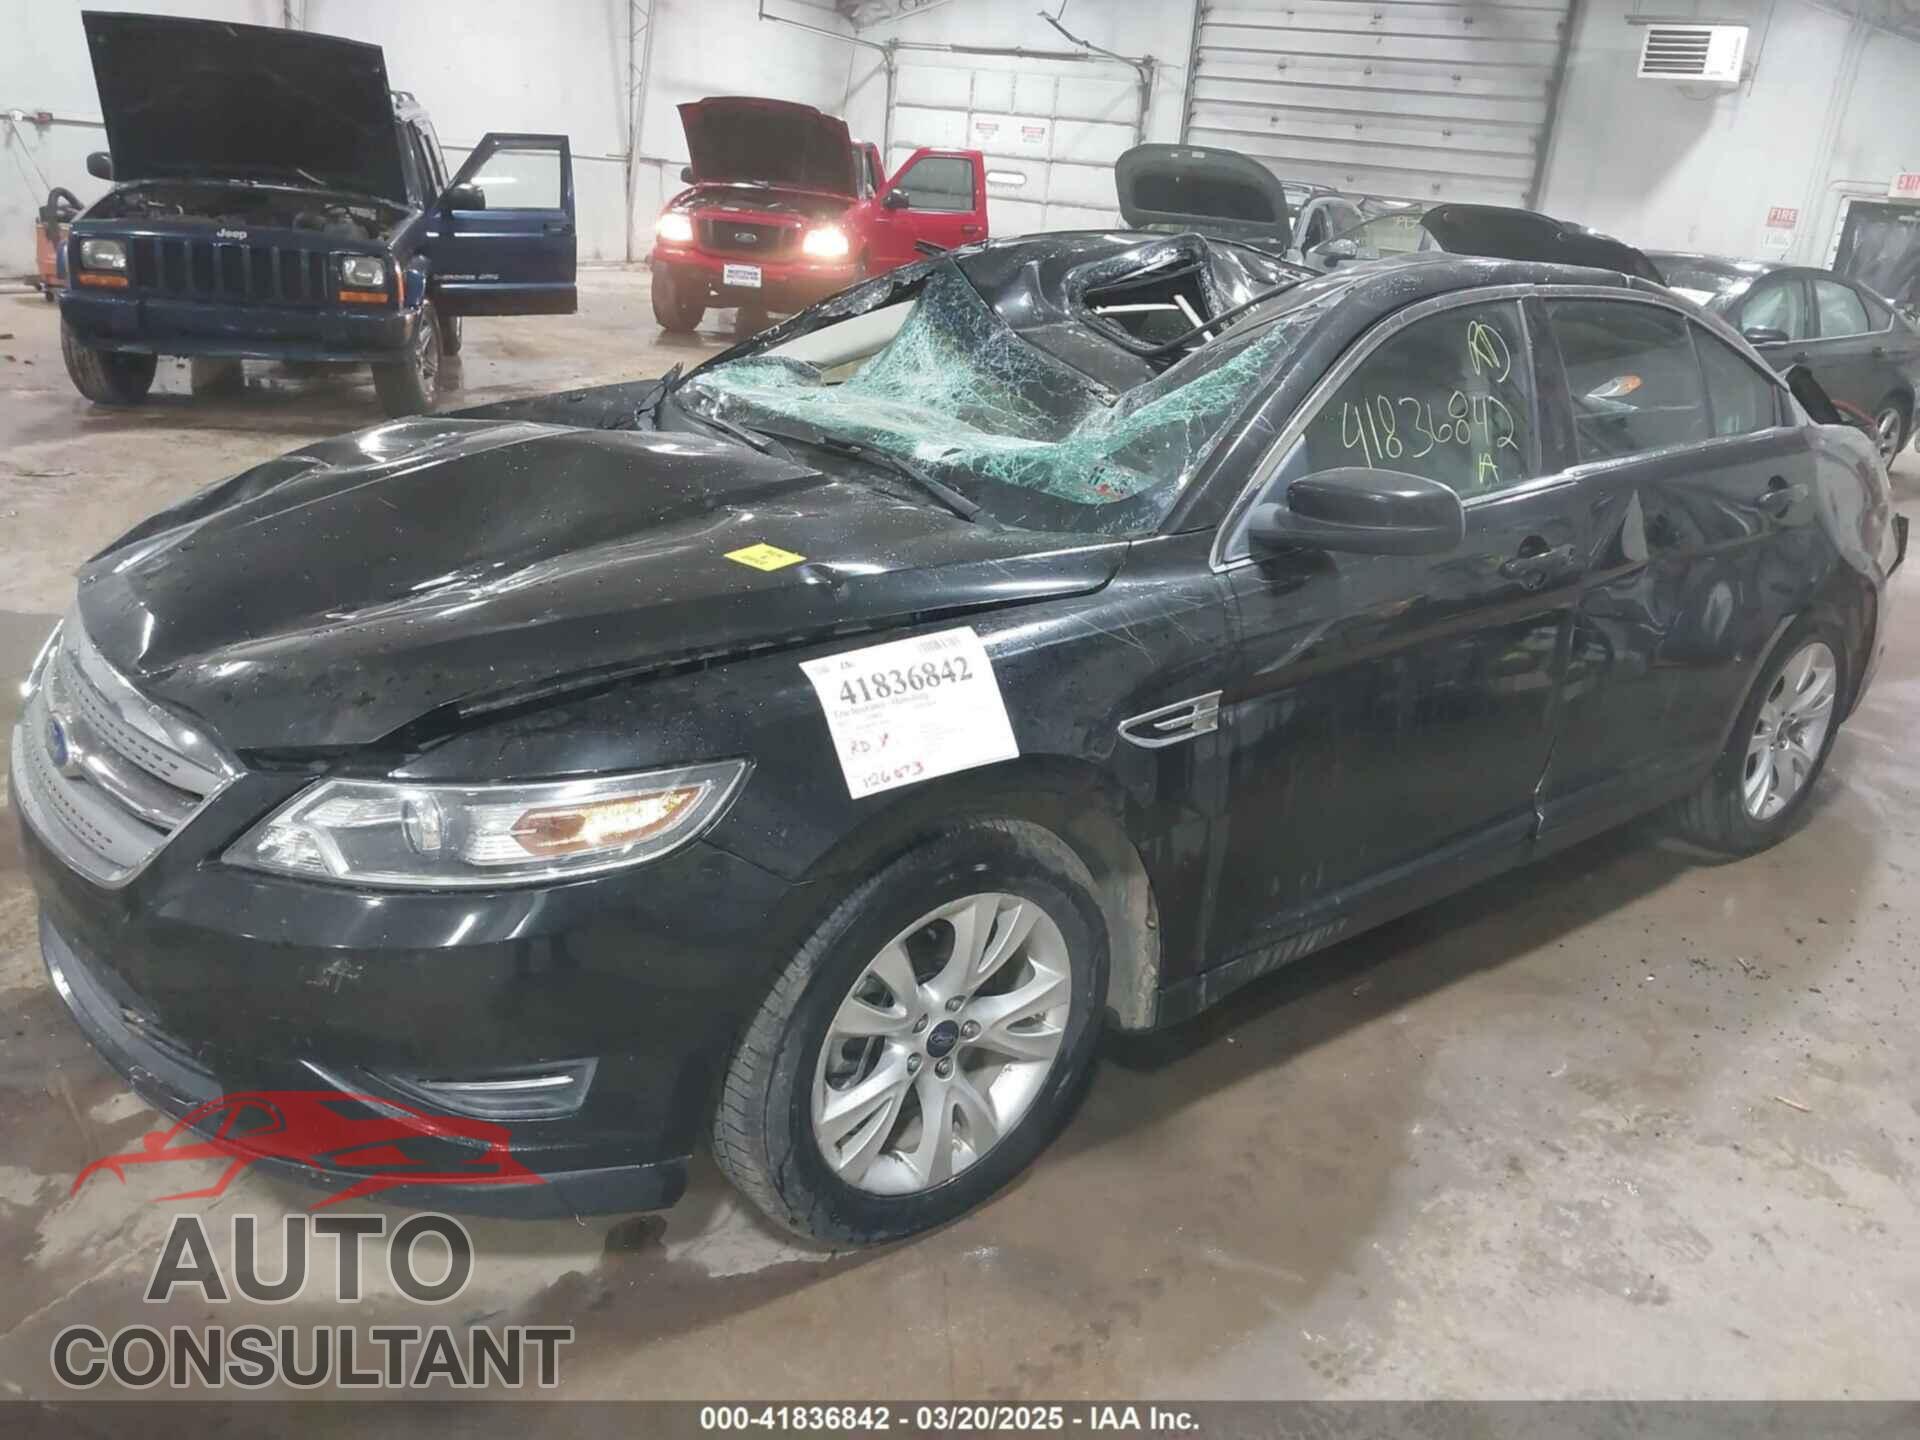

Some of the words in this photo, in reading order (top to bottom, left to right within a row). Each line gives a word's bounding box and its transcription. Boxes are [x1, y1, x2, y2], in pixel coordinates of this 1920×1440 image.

[1769, 209, 1797, 222] FIRE
[216, 228, 247, 240] Jeep
[1342, 390, 1519, 469] 41836842
[839, 656, 973, 705] 41836842
